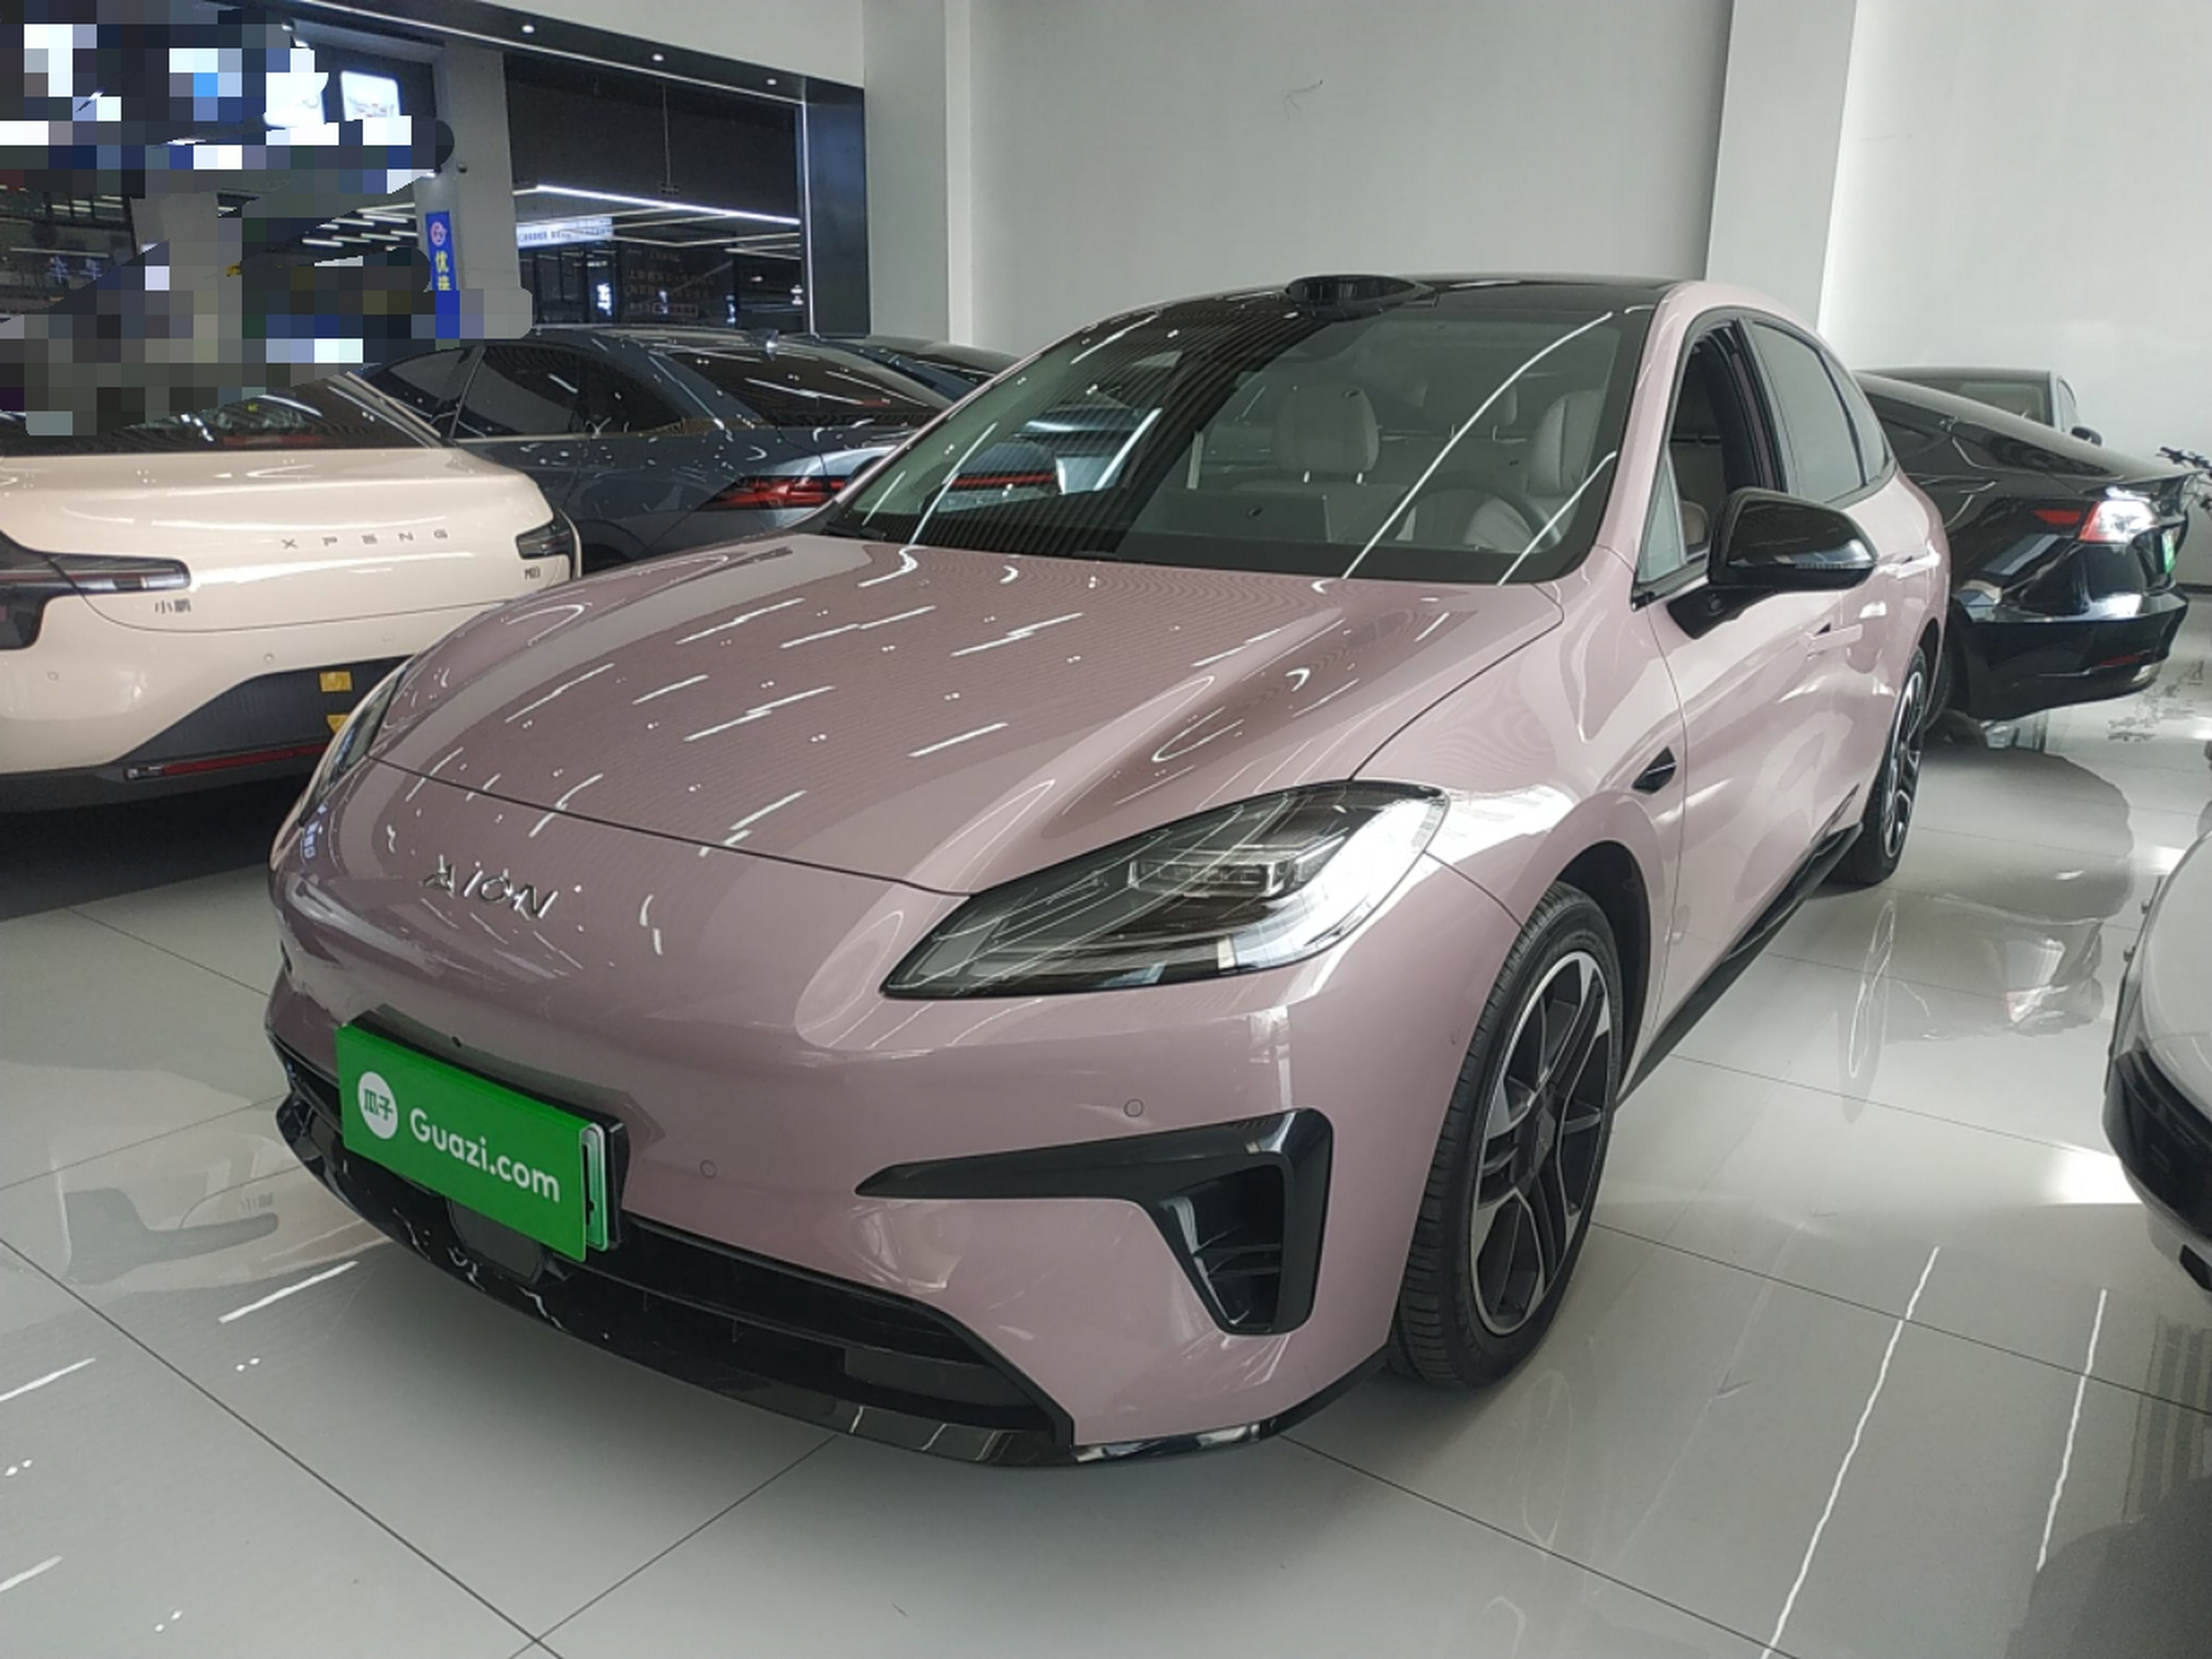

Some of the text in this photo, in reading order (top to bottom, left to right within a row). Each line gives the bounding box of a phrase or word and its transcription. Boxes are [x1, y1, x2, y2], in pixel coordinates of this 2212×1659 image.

[281, 529, 448, 550] XPENG
[423, 863, 559, 918] AION
[363, 1088, 394, 1122] 瓜子
[410, 1108, 560, 1203] Guazi.com
